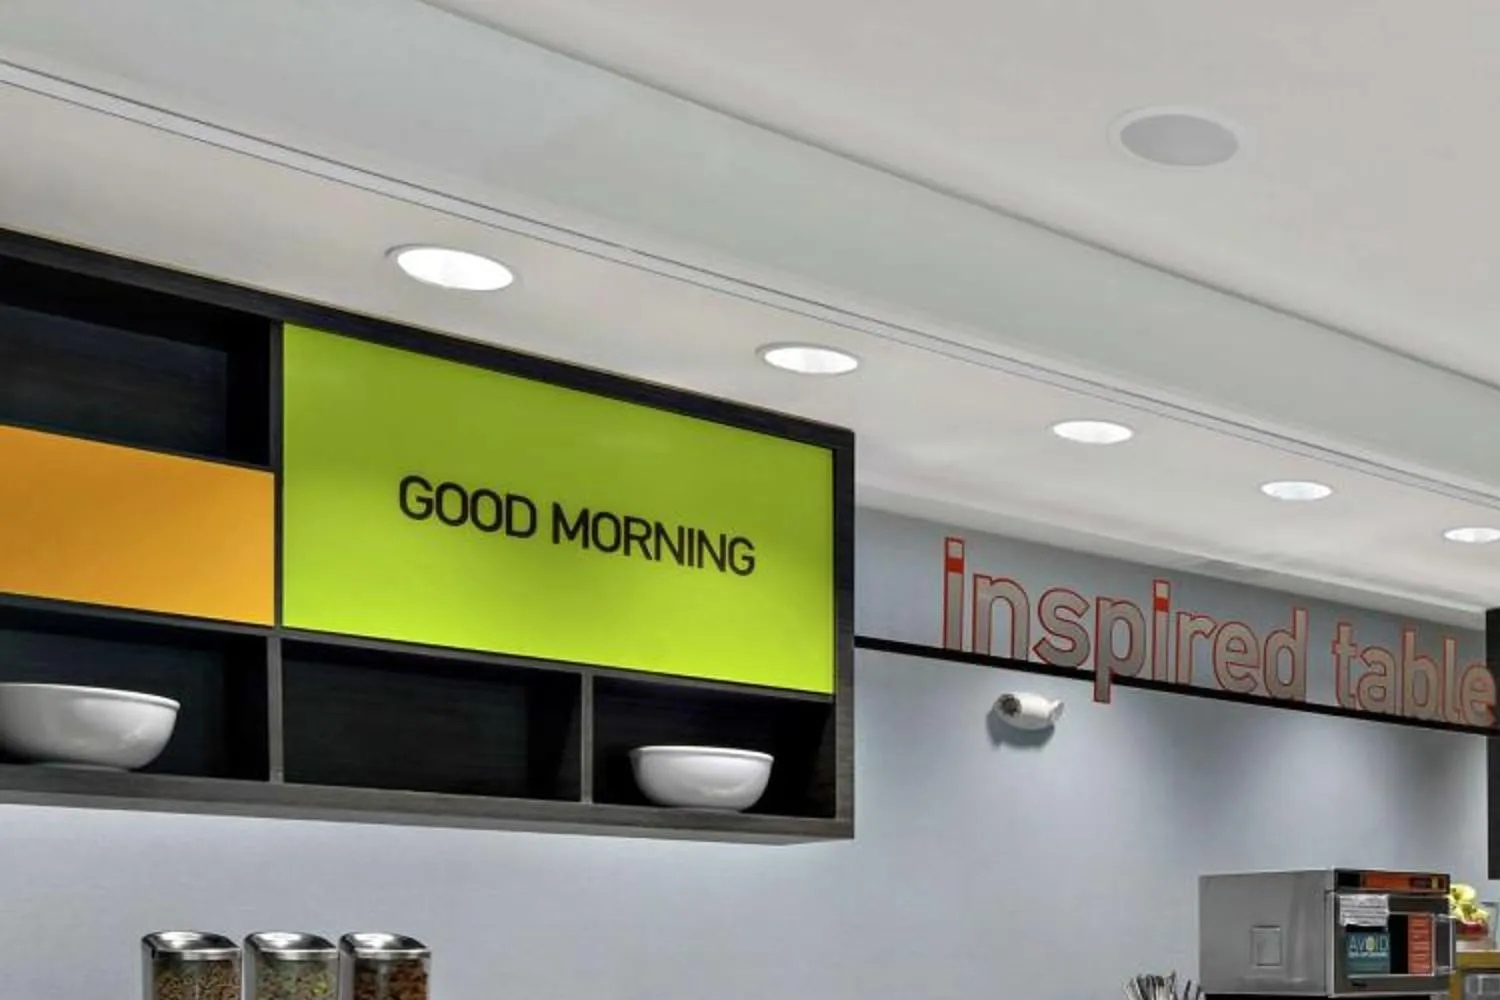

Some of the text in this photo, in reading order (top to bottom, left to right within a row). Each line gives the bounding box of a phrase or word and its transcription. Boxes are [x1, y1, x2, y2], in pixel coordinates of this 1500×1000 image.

[399, 474, 756, 577] GOOD MORNING
[943, 536, 1498, 727] inspired table
